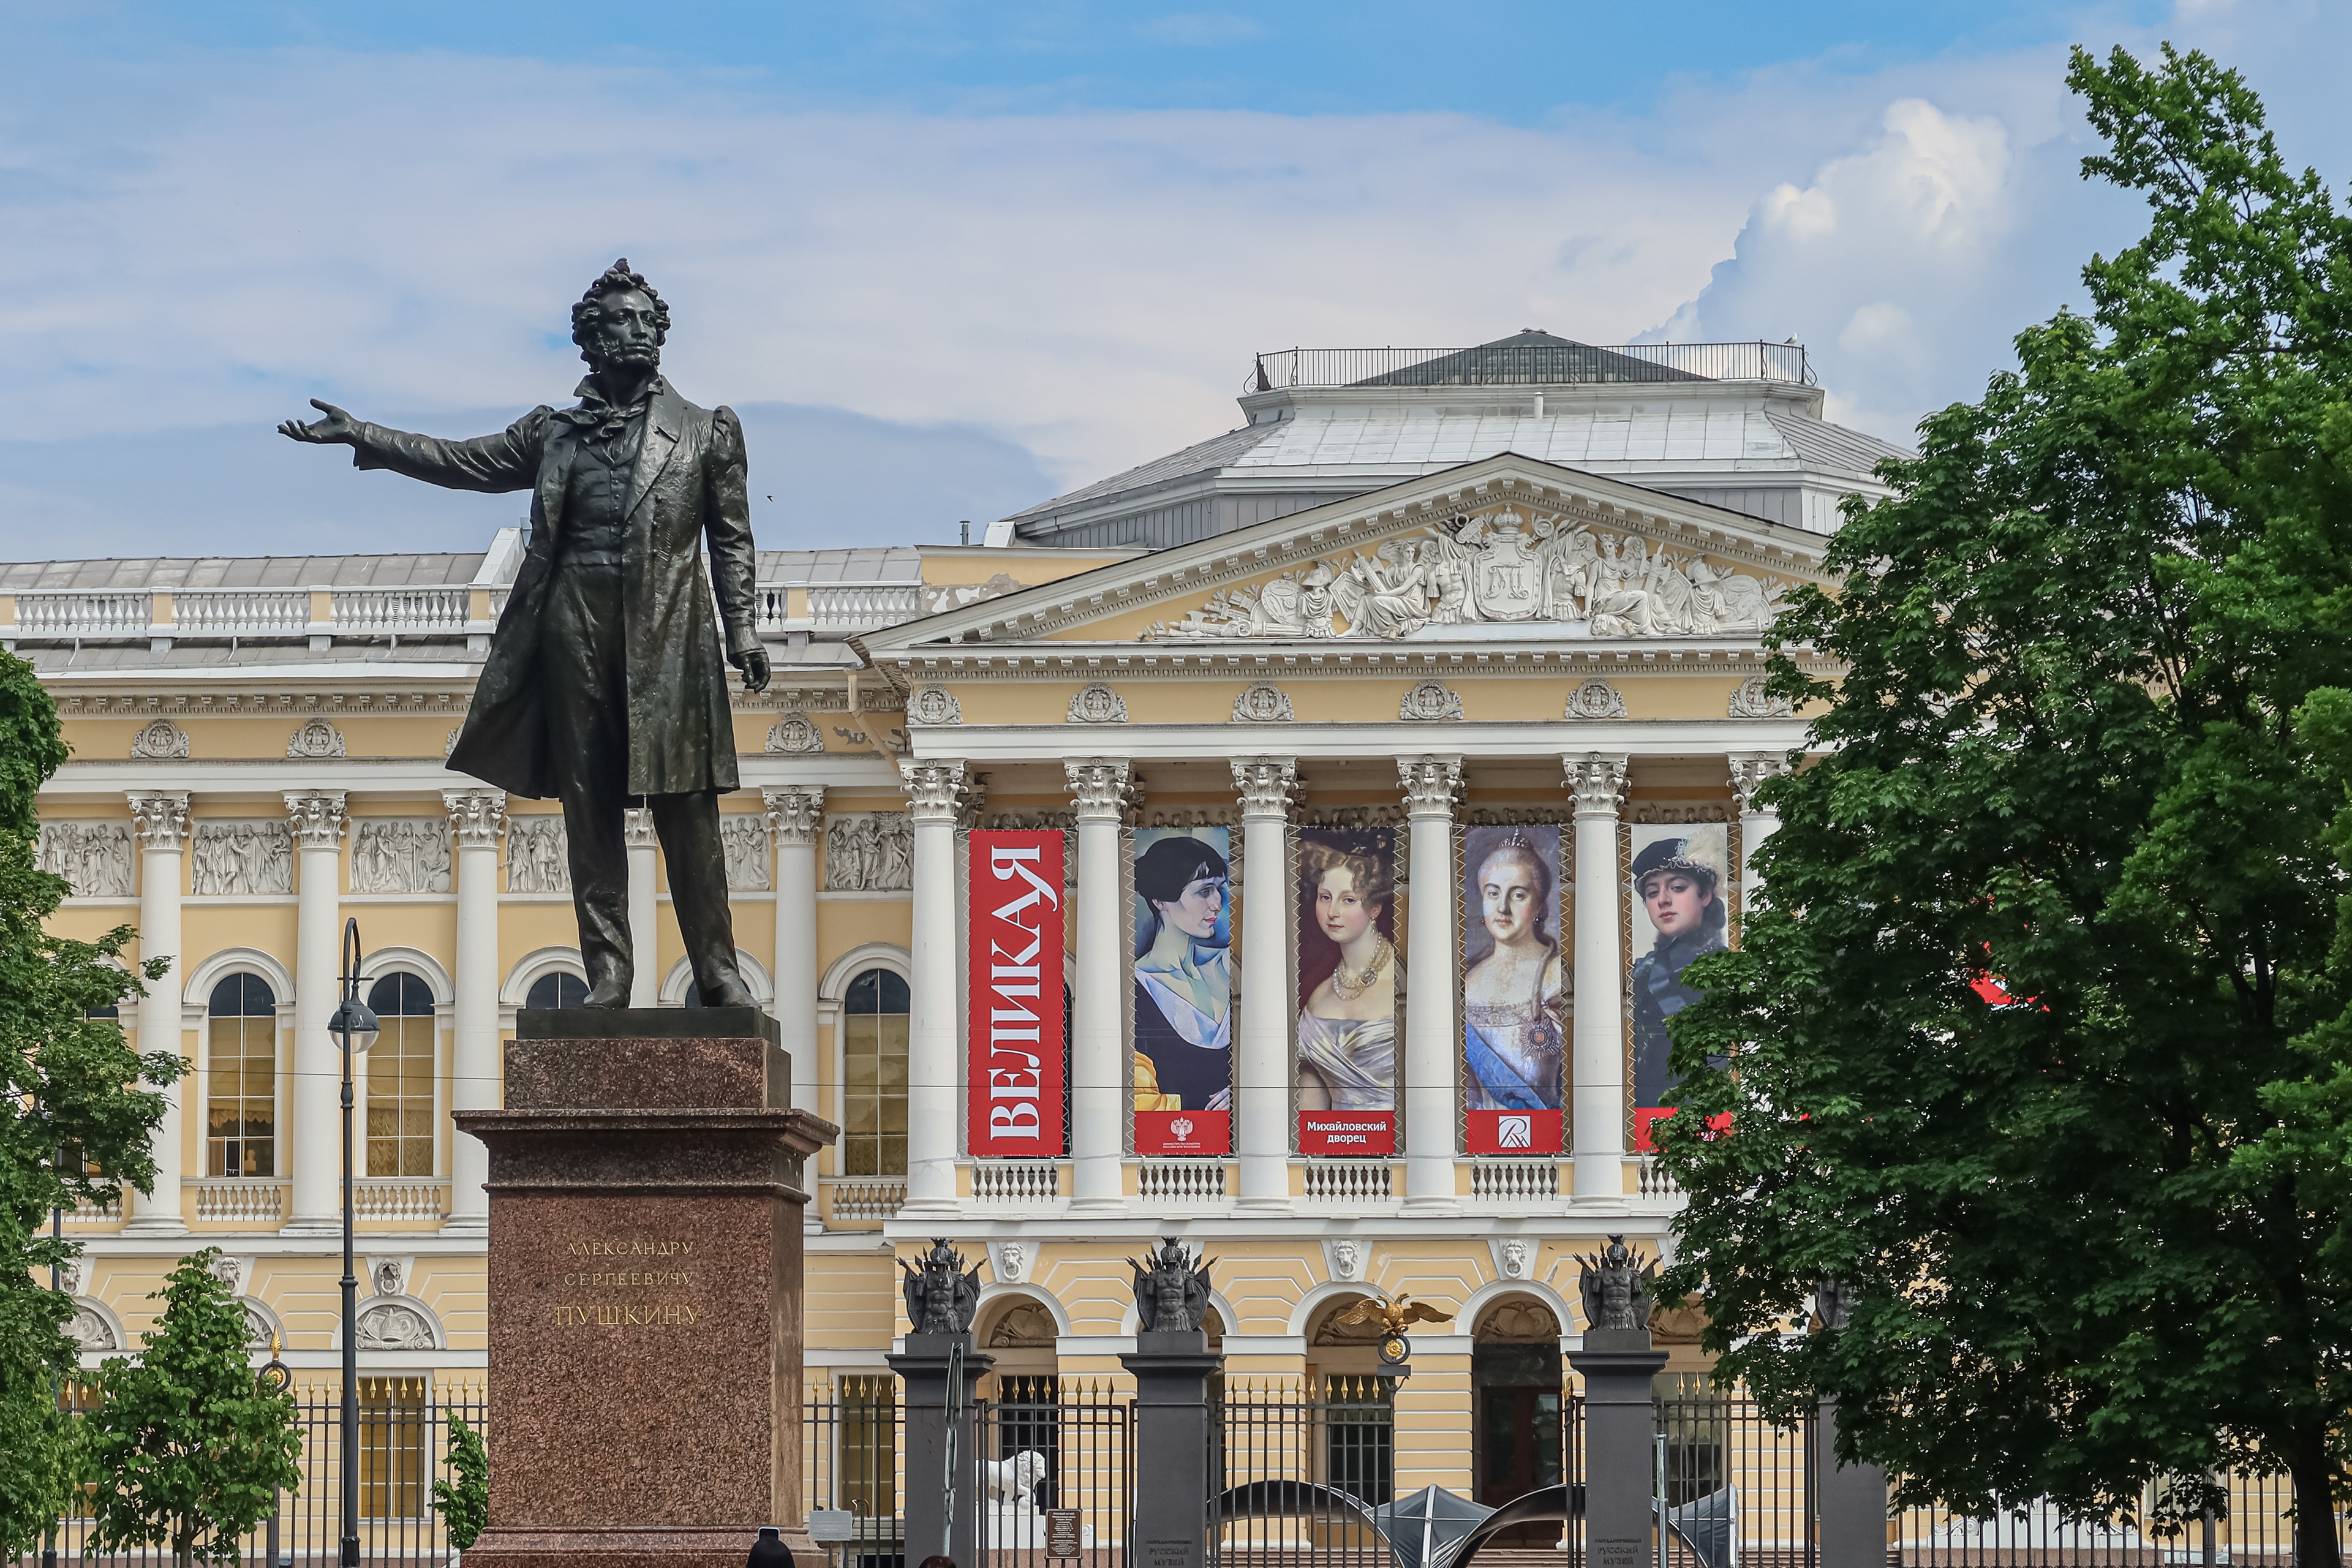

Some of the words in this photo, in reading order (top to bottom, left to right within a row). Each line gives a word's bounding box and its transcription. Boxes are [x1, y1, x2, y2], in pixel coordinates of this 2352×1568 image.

[987, 845, 1058, 1140] ВЕЛИКАЯ
[1306, 1121, 1387, 1131] Михайловский
[1327, 1134, 1366, 1145] дворец
[565, 1242, 695, 1255] АЛЕКСАНДРУ
[564, 1272, 693, 1286] СЕРГЕЕВИЧУ
[556, 1305, 702, 1325] ПУШКИНУ
[1597, 1545, 1639, 1555] РУССКИЙ
